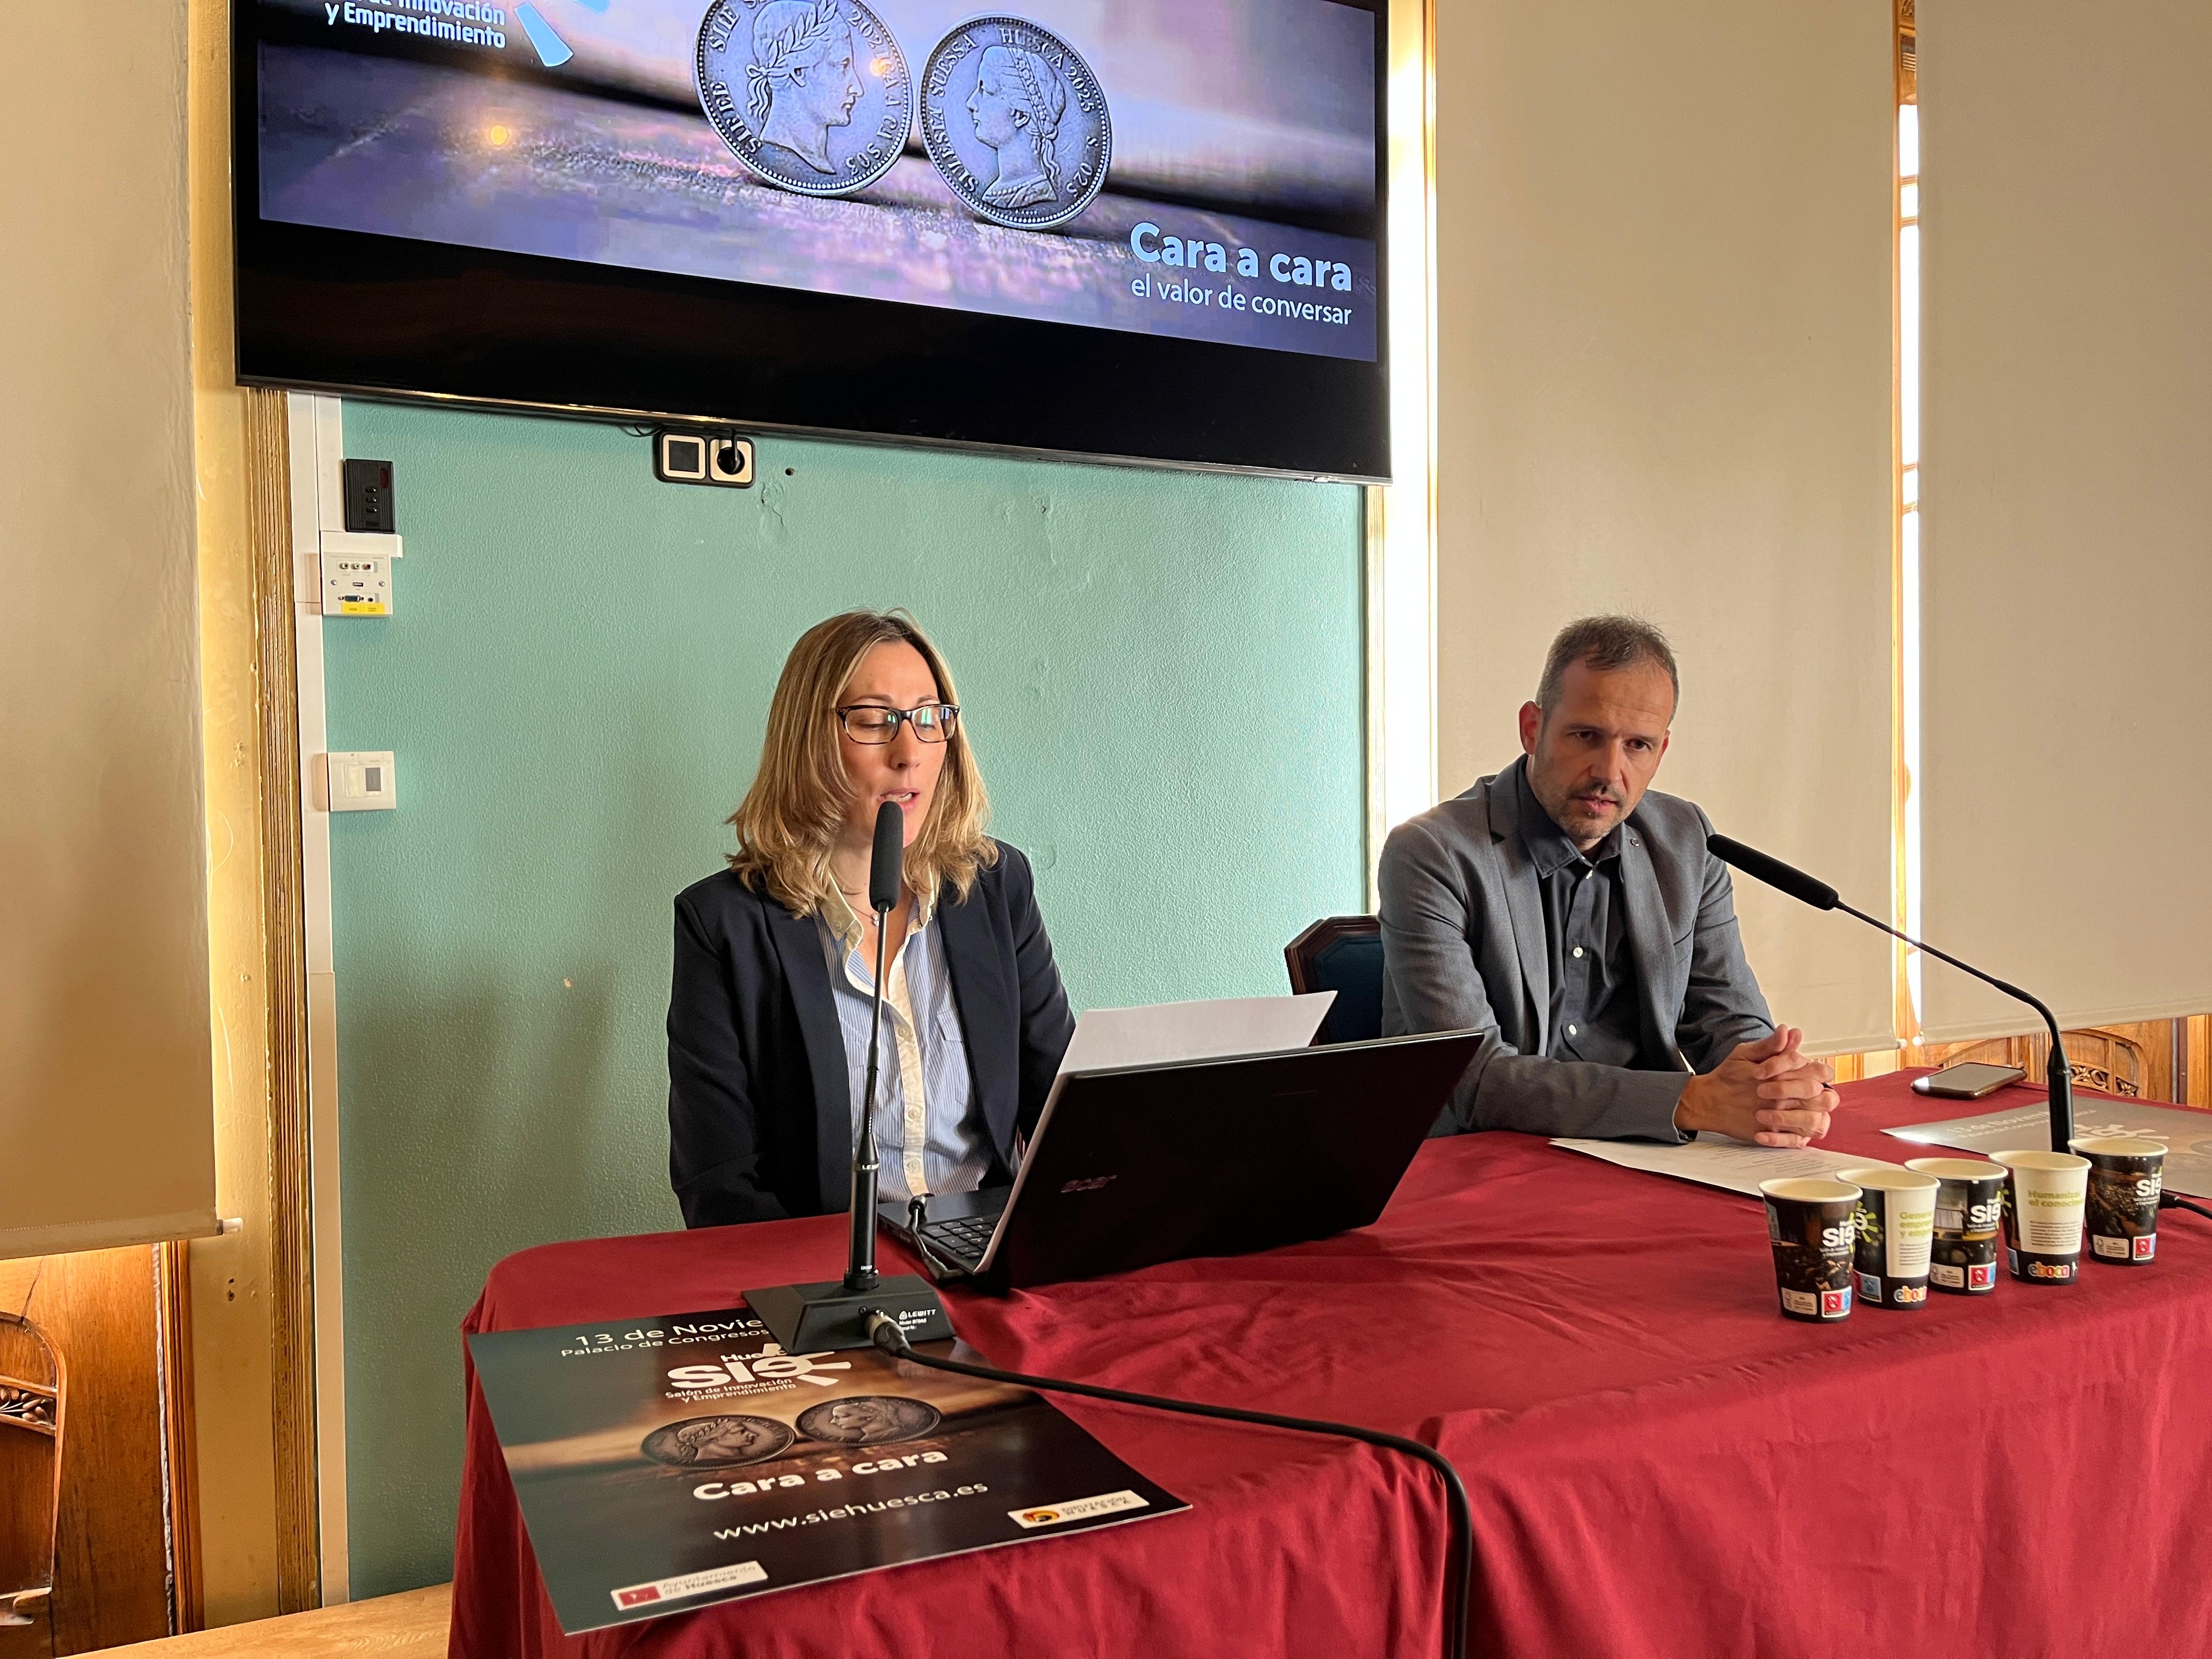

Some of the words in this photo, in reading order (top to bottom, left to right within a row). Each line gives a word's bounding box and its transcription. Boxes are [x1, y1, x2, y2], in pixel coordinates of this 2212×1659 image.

[324, 2, 340, 25] y
[344, 2, 506, 48] Emprendimiento
[1130, 222, 1227, 273] Cara
[1237, 247, 1259, 278] a
[1269, 253, 1352, 292] cara
[1131, 273, 1150, 298] el
[1157, 279, 1212, 306] valor
[1218, 285, 1246, 311] de
[1251, 296, 1352, 325] conversar
[1061, 1175, 1118, 1193] acer
[908, 1309, 936, 1318] LEWITT
[561, 1344, 633, 1357] Palacio
[638, 1339, 663, 1347] de
[668, 1329, 769, 1344] Congresos
[575, 1334, 614, 1346] 13
[624, 1329, 665, 1340] de
[672, 1319, 764, 1335] Novie
[665, 1389, 704, 1398] Salón
[723, 1378, 793, 1392] Innovación
[692, 1384, 797, 1401] Emprendimiento
[693, 1473, 805, 1500] Cara
[815, 1468, 843, 1482] a
[851, 1450, 949, 1475] cara
[713, 1482, 988, 1540] www.siehuesca.es
